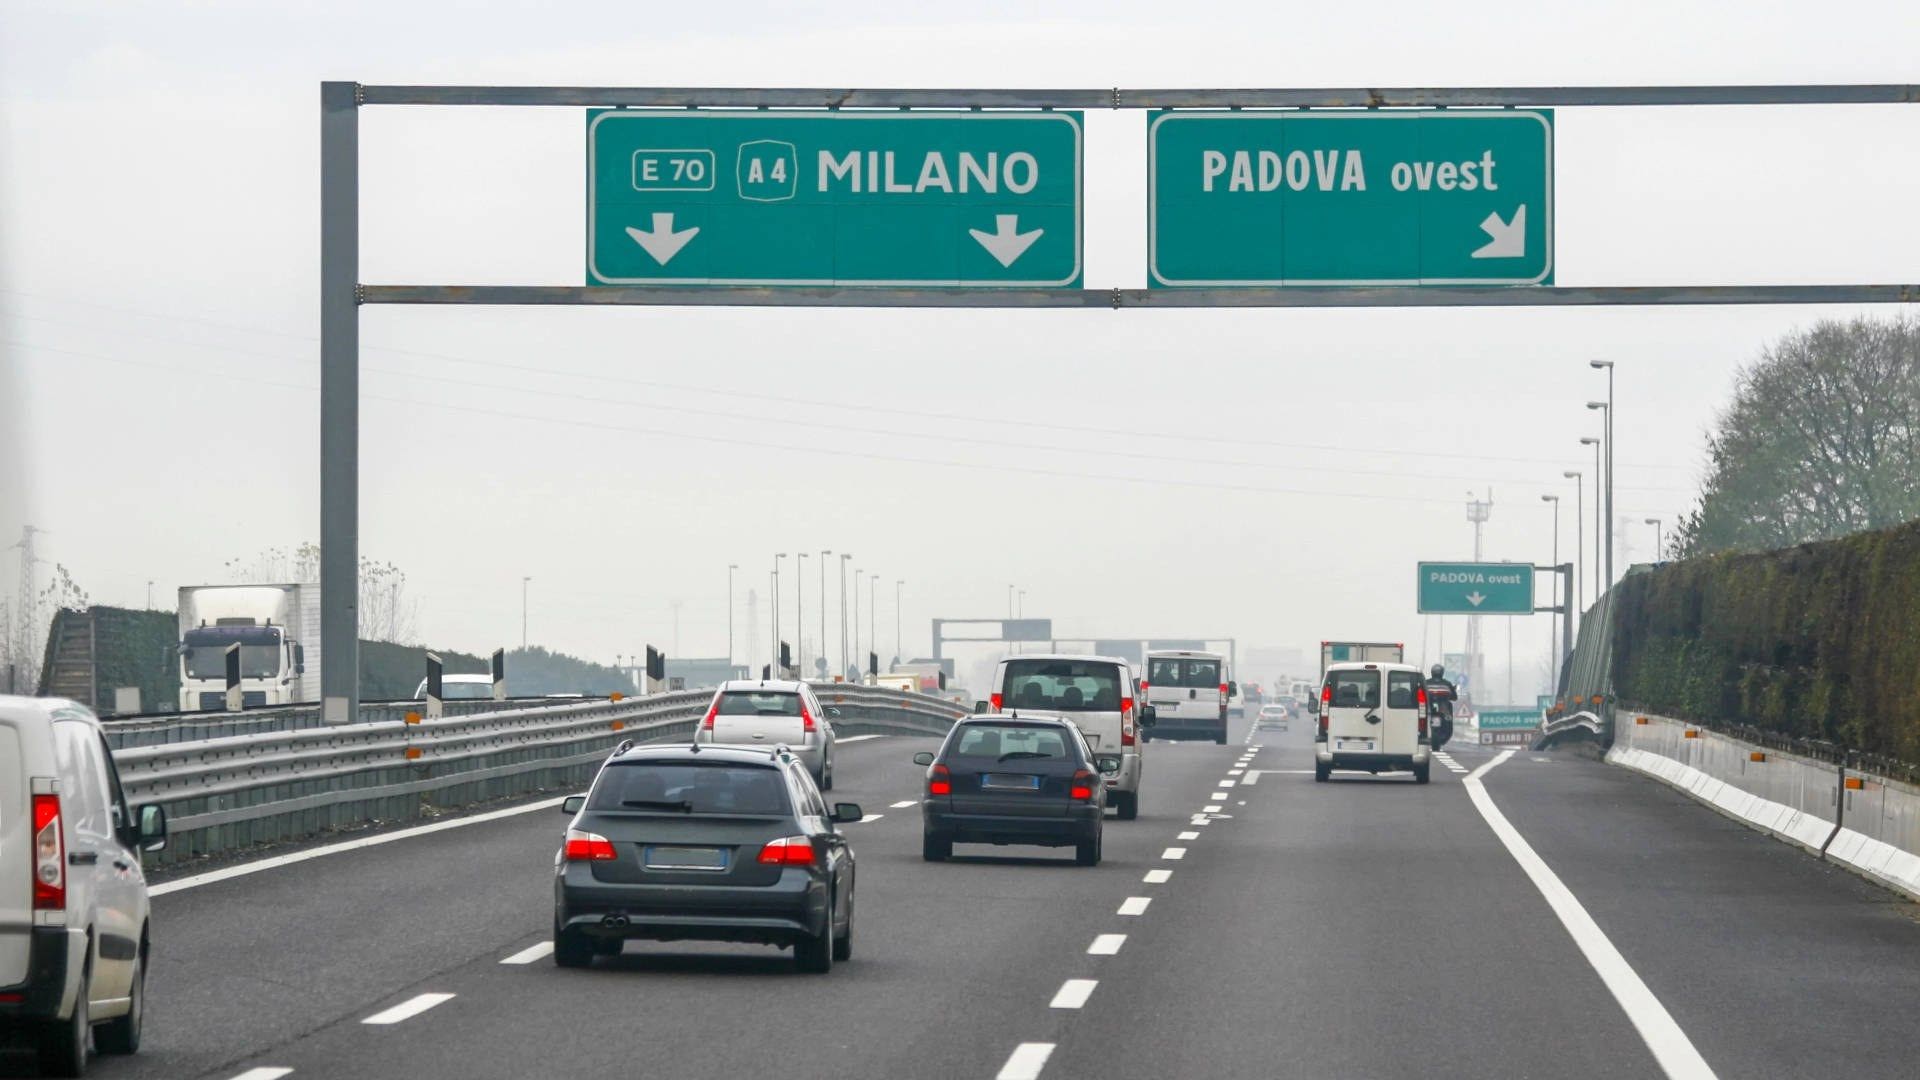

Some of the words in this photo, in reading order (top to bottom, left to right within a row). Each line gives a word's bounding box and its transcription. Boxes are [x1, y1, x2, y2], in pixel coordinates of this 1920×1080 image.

[643, 160, 659, 181] E
[671, 160, 704, 181] 70
[818, 150, 1039, 194] MILANO
[1203, 150, 1366, 192] PADOVA
[1391, 150, 1498, 192] ovest
[1430, 572, 1485, 584] PADOVA
[1488, 574, 1521, 585] ovest
